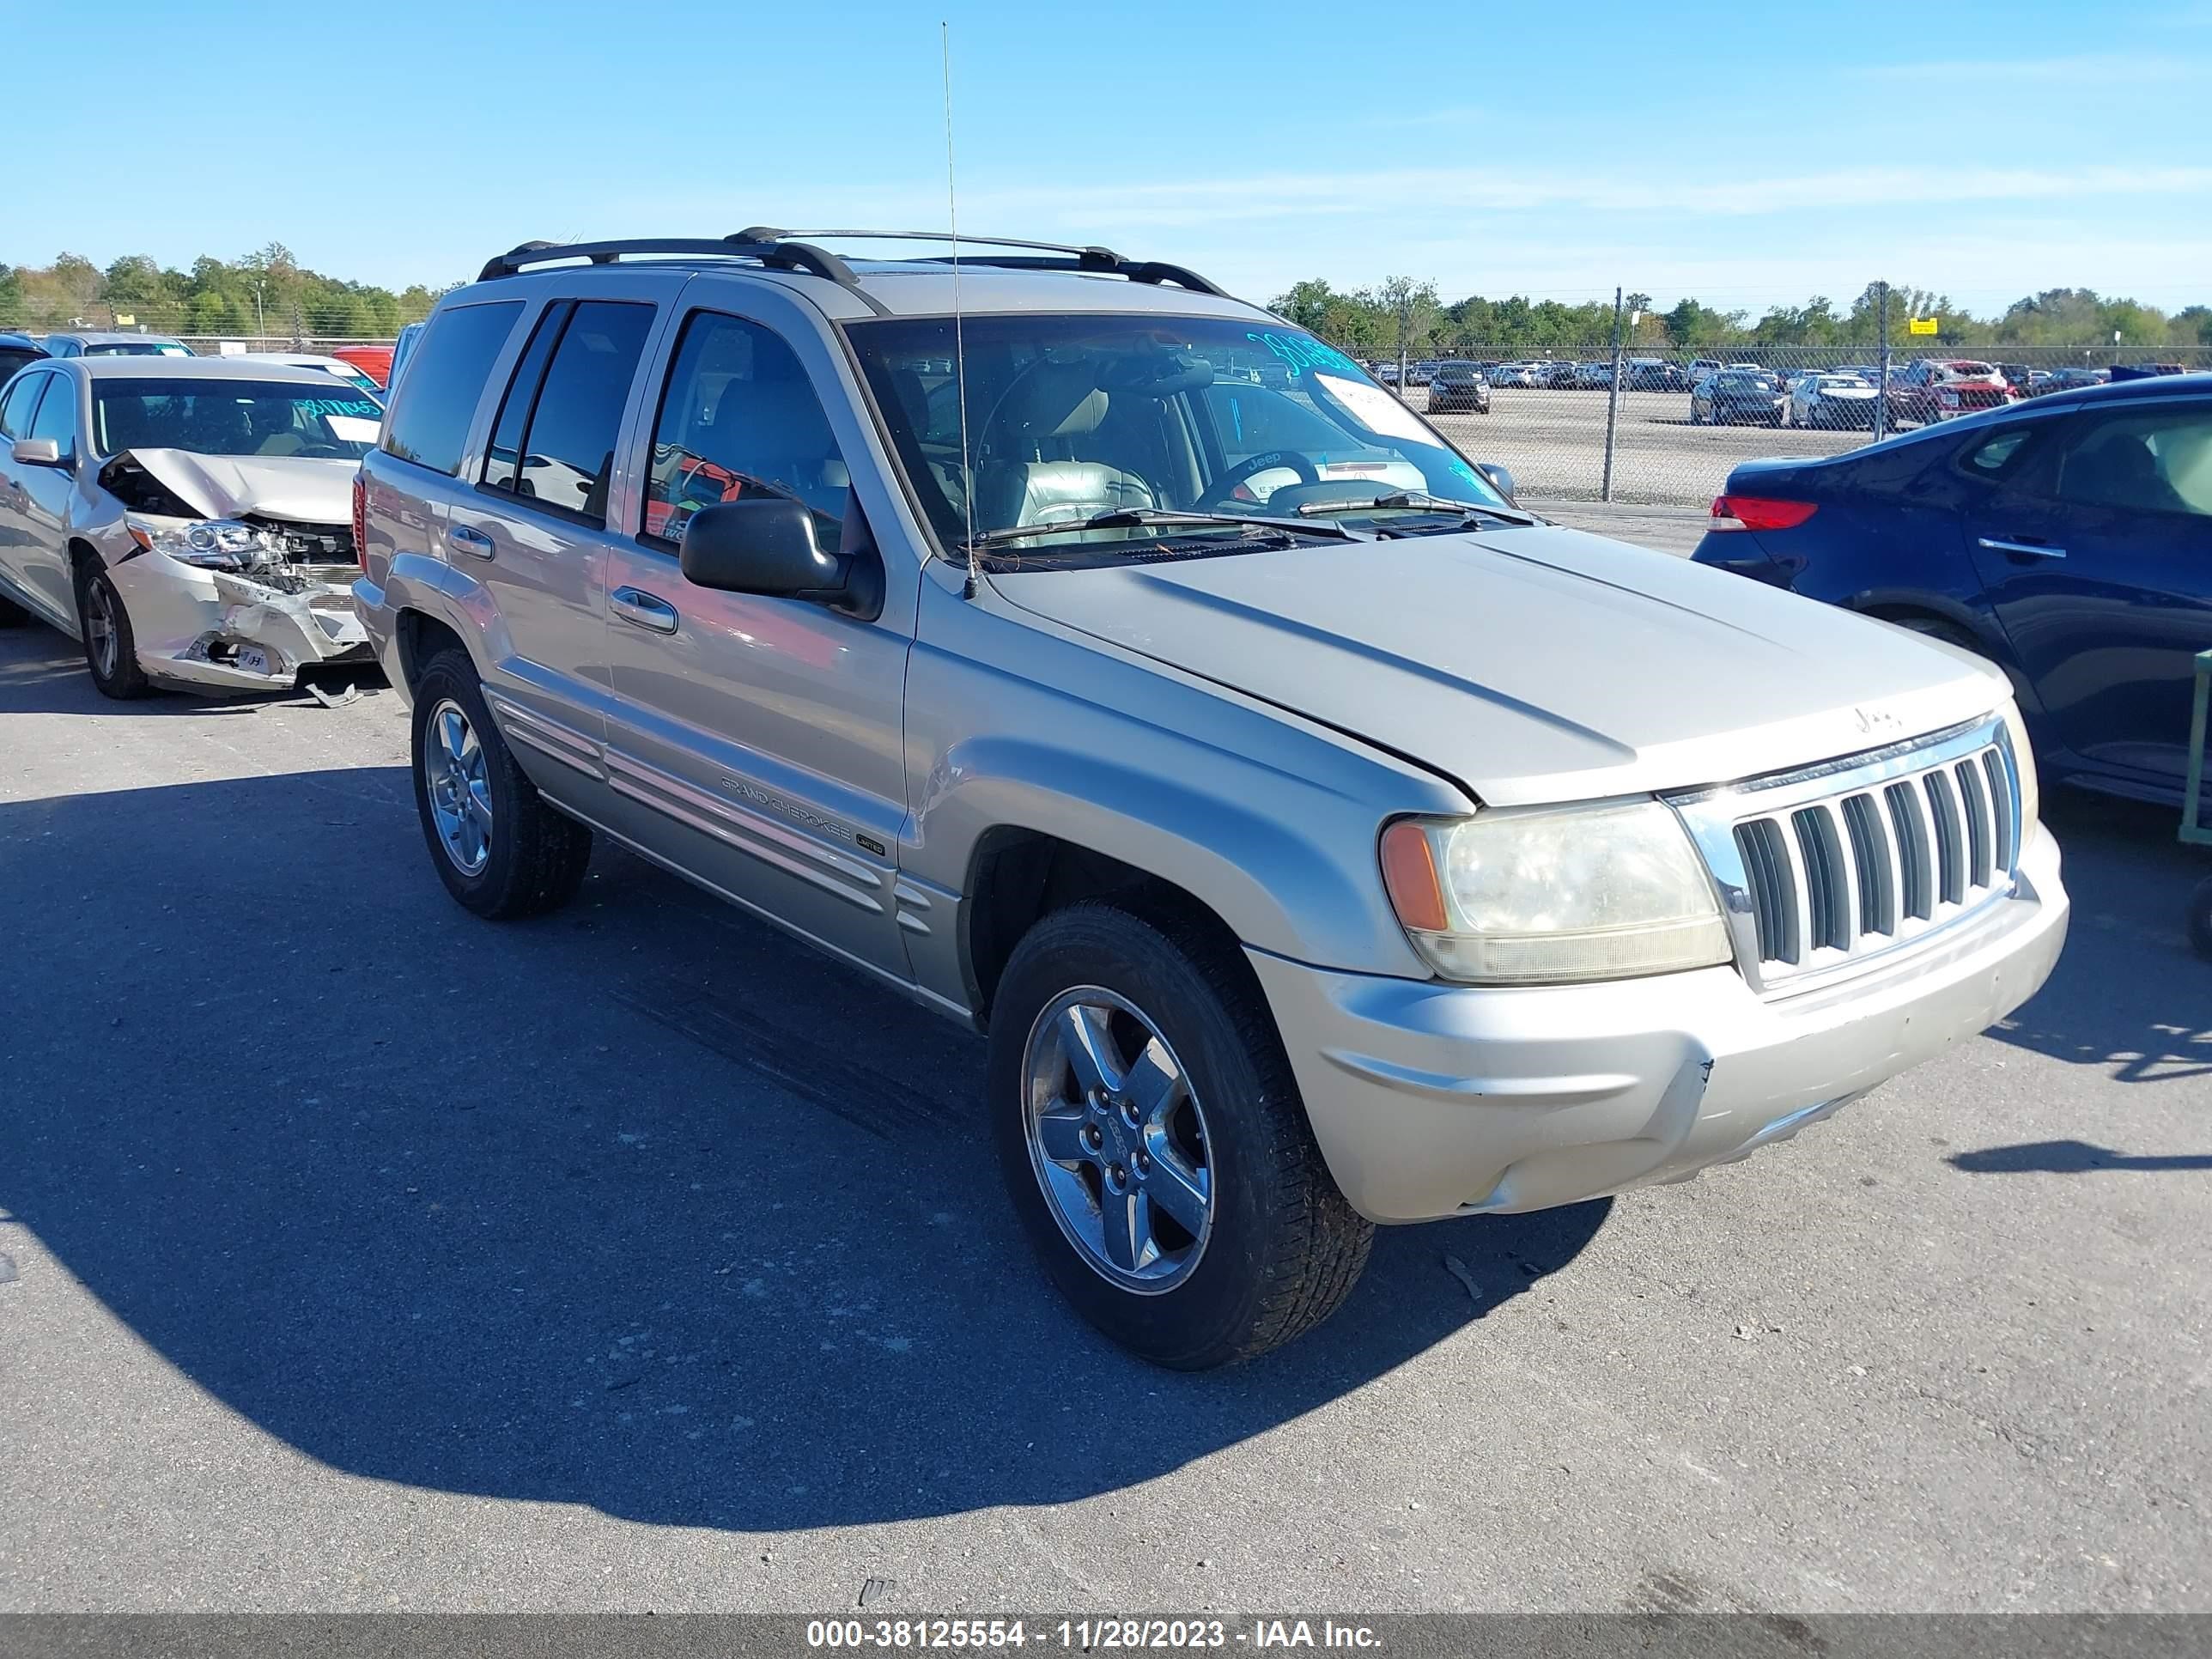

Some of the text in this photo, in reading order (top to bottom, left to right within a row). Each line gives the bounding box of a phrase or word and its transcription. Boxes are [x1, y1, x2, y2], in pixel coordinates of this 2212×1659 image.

[1248, 453, 1281, 471] Jeep
[721, 776, 884, 854] GRAND CHEROKEE LIMITED
